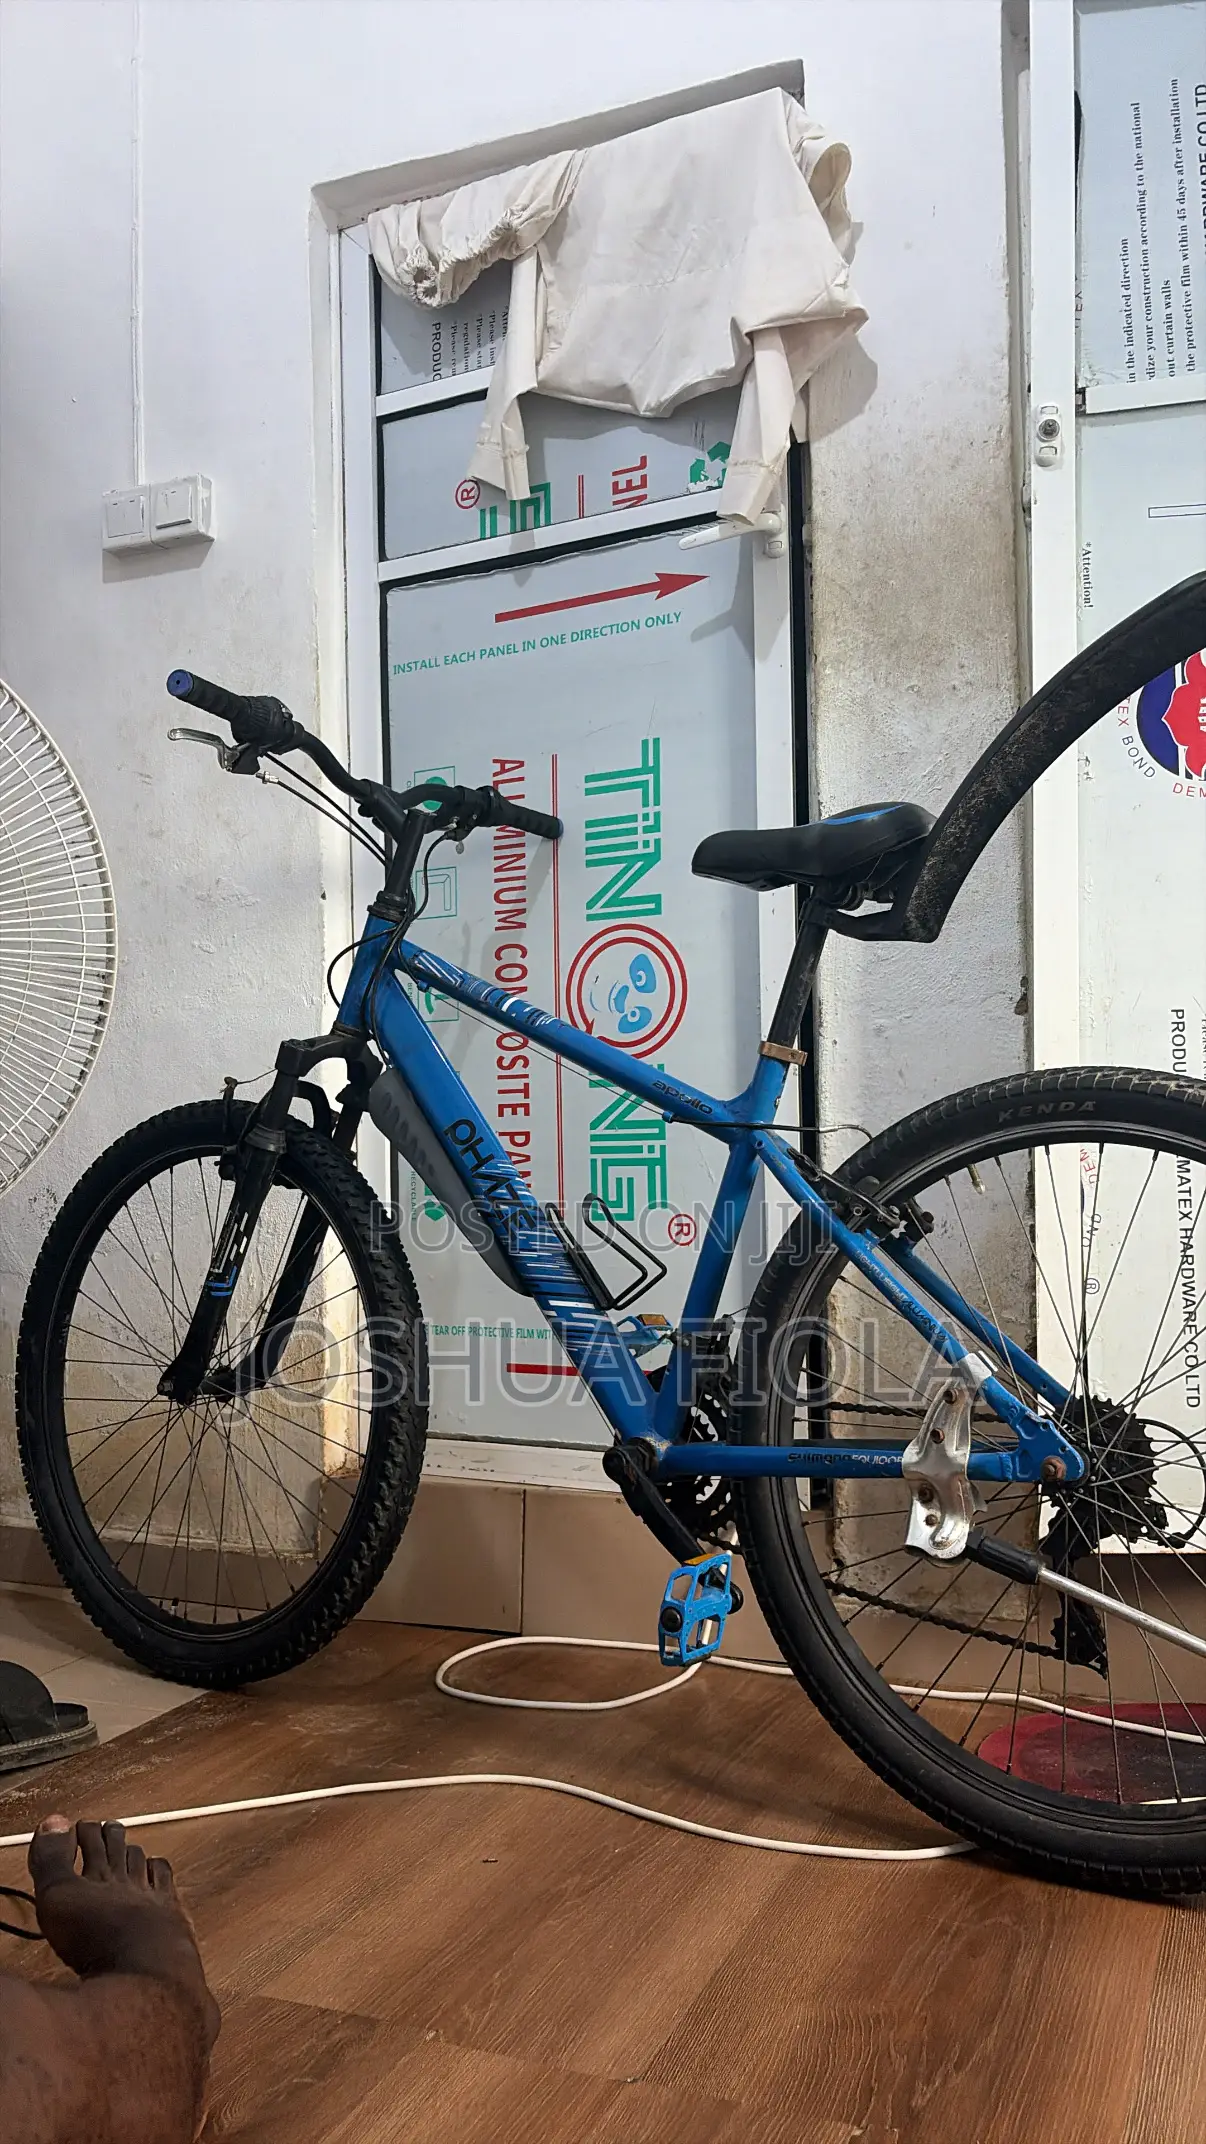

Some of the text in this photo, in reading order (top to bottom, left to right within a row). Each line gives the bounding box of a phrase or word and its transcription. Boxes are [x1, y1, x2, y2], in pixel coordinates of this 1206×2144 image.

[1130, 102, 1157, 381] dize your construction according to the national
[1169, 78, 1196, 372] the protective film within 45 days after installation
[1119, 237, 1136, 384] in the indicated direction
[1161, 279, 1173, 310] walls
[1162, 312, 1176, 356] curtain
[392, 611, 682, 675] INSTALL EACH PANEL IN ONE DIRECTION ONLY
[1122, 735, 1156, 779] BOND
[492, 758, 527, 932] ALMINIUM
[494, 943, 531, 1118] COOSITE
[998, 1100, 1097, 1123] KENDA
[431, 1324, 450, 1336] TEAR
[451, 1325, 466, 1336] OFF
[467, 1325, 515, 1338] PROTECTIVE
[515, 1327, 536, 1339] FILM
[1177, 1160, 1201, 1409] MATEX HARDWARE CO LTD
